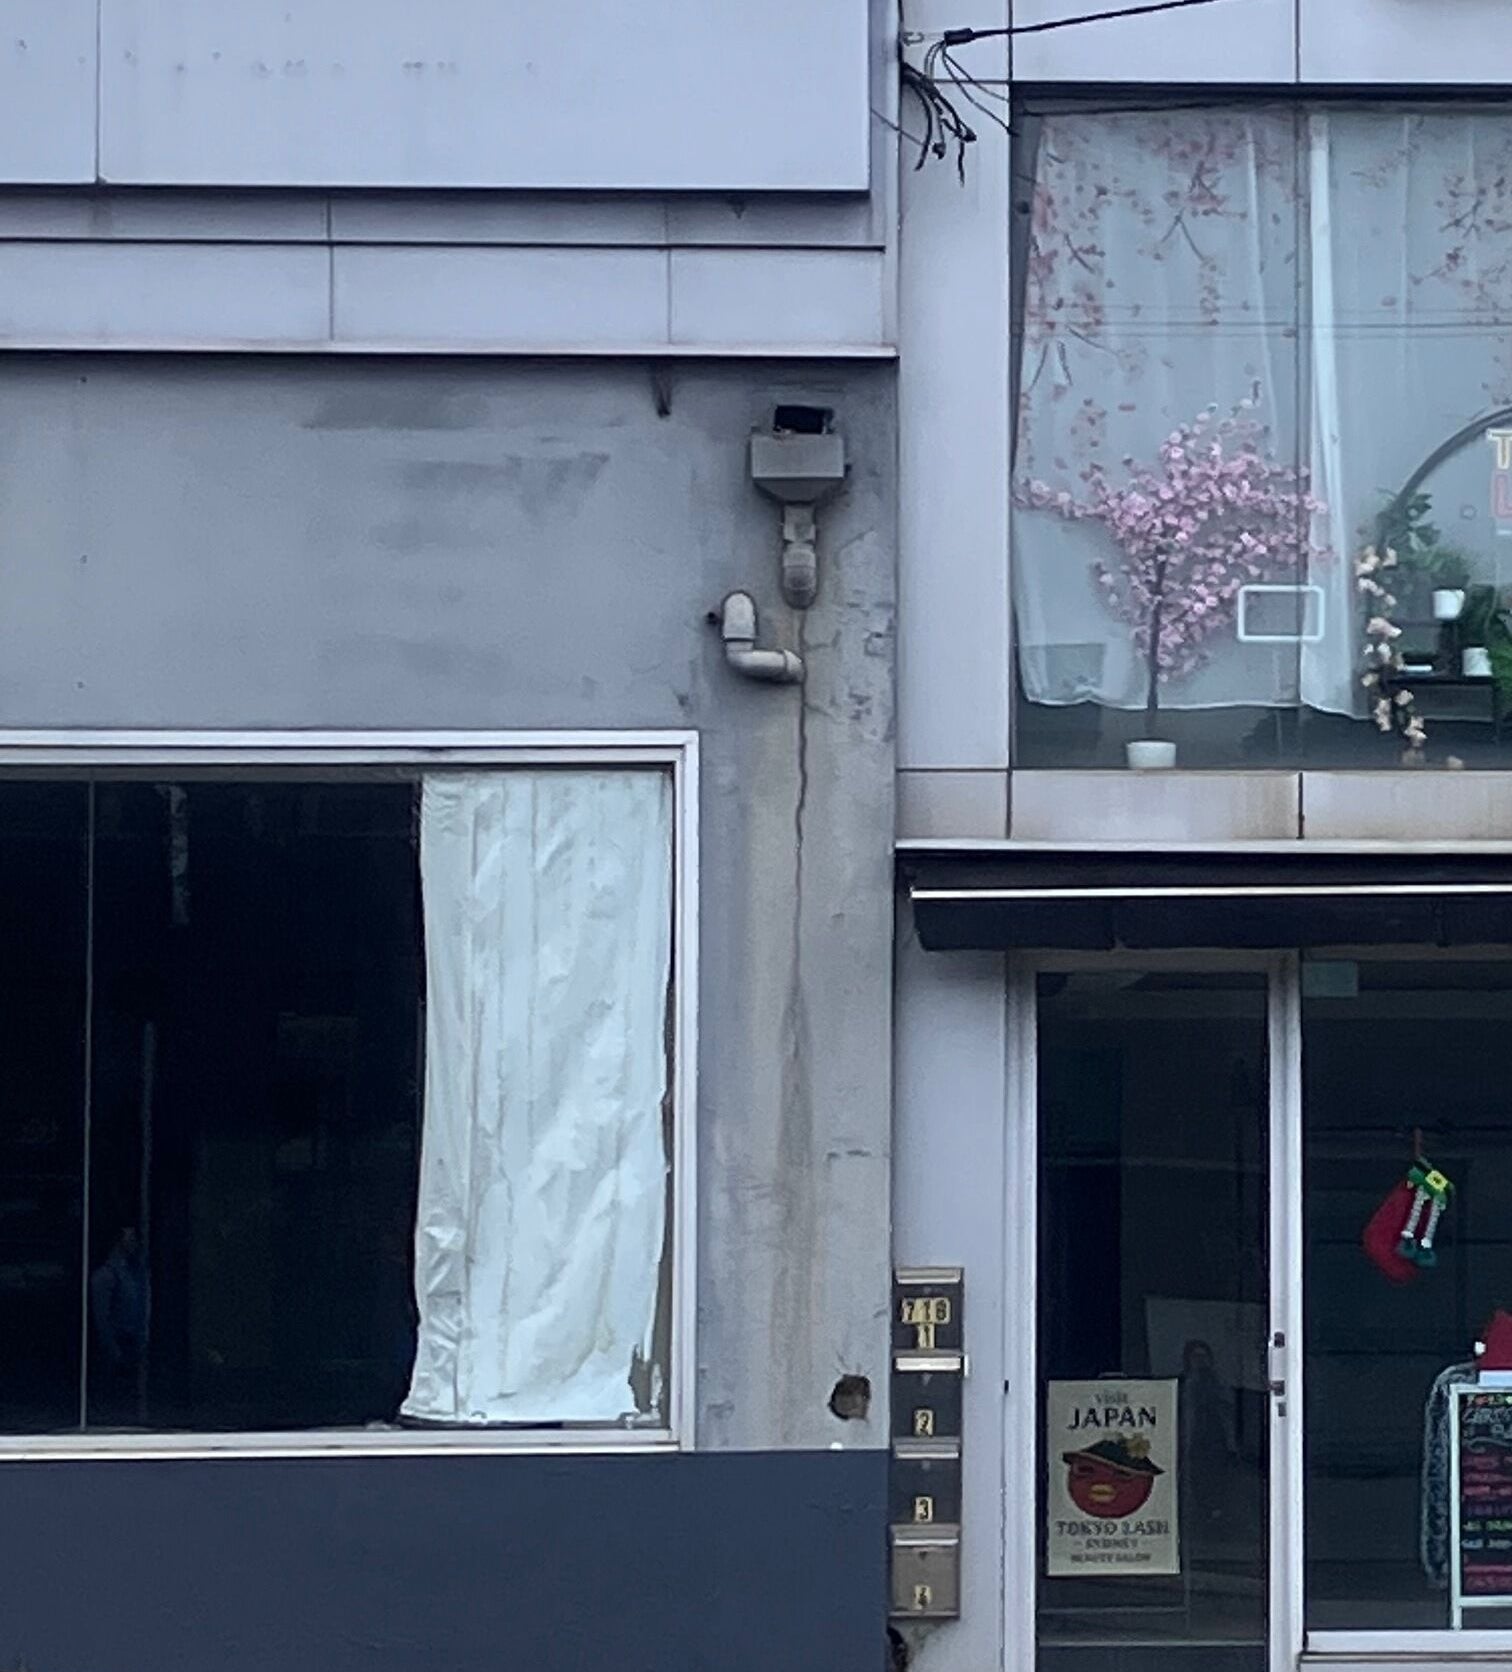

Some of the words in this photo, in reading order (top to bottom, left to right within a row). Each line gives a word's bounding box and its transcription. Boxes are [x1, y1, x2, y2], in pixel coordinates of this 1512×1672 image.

[1065, 1405, 1157, 1430] JAPAN
[1055, 1520, 1118, 1536] TOKYO
[1121, 1520, 1170, 1536] LASH
